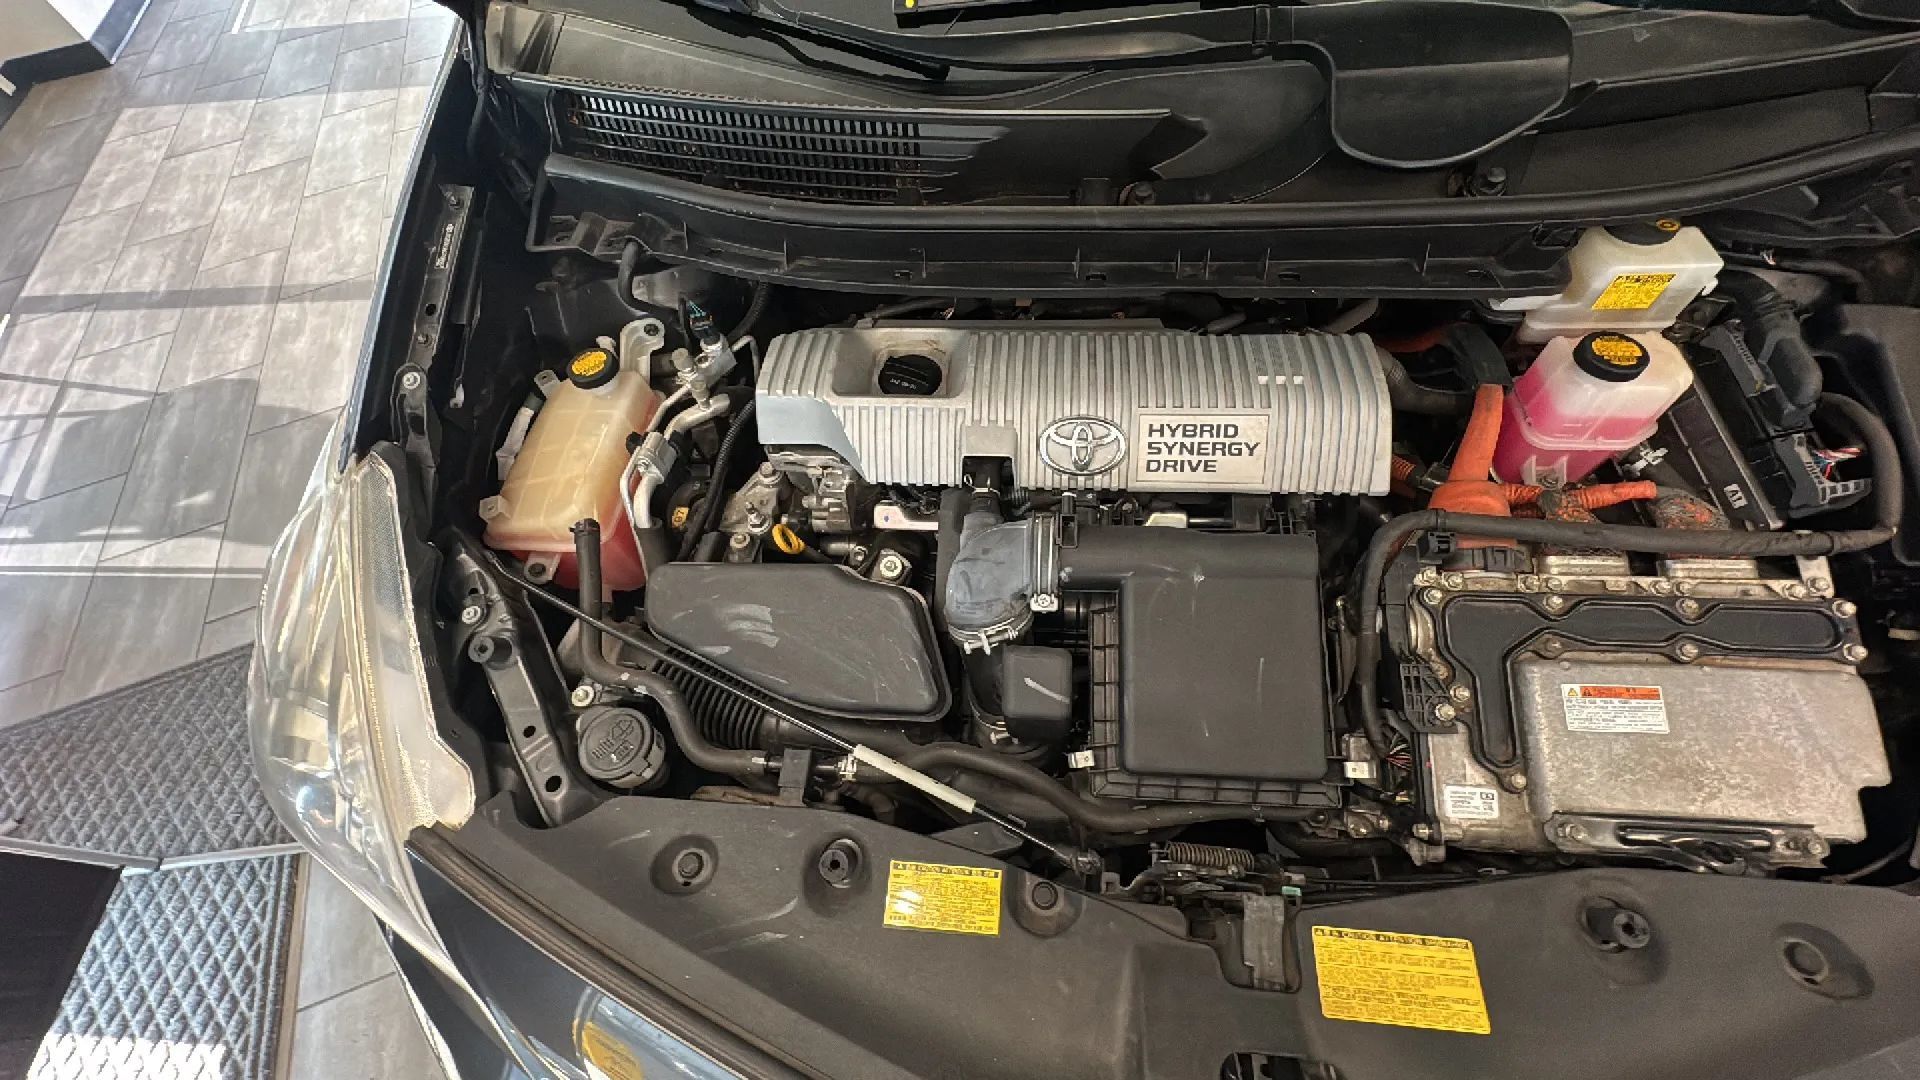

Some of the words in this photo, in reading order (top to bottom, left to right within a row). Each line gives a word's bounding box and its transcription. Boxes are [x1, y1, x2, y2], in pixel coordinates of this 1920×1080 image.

[1148, 423, 1239, 438] HYBRID
[1147, 441, 1260, 457] SYNERGY
[1146, 459, 1217, 473] DRIVE
